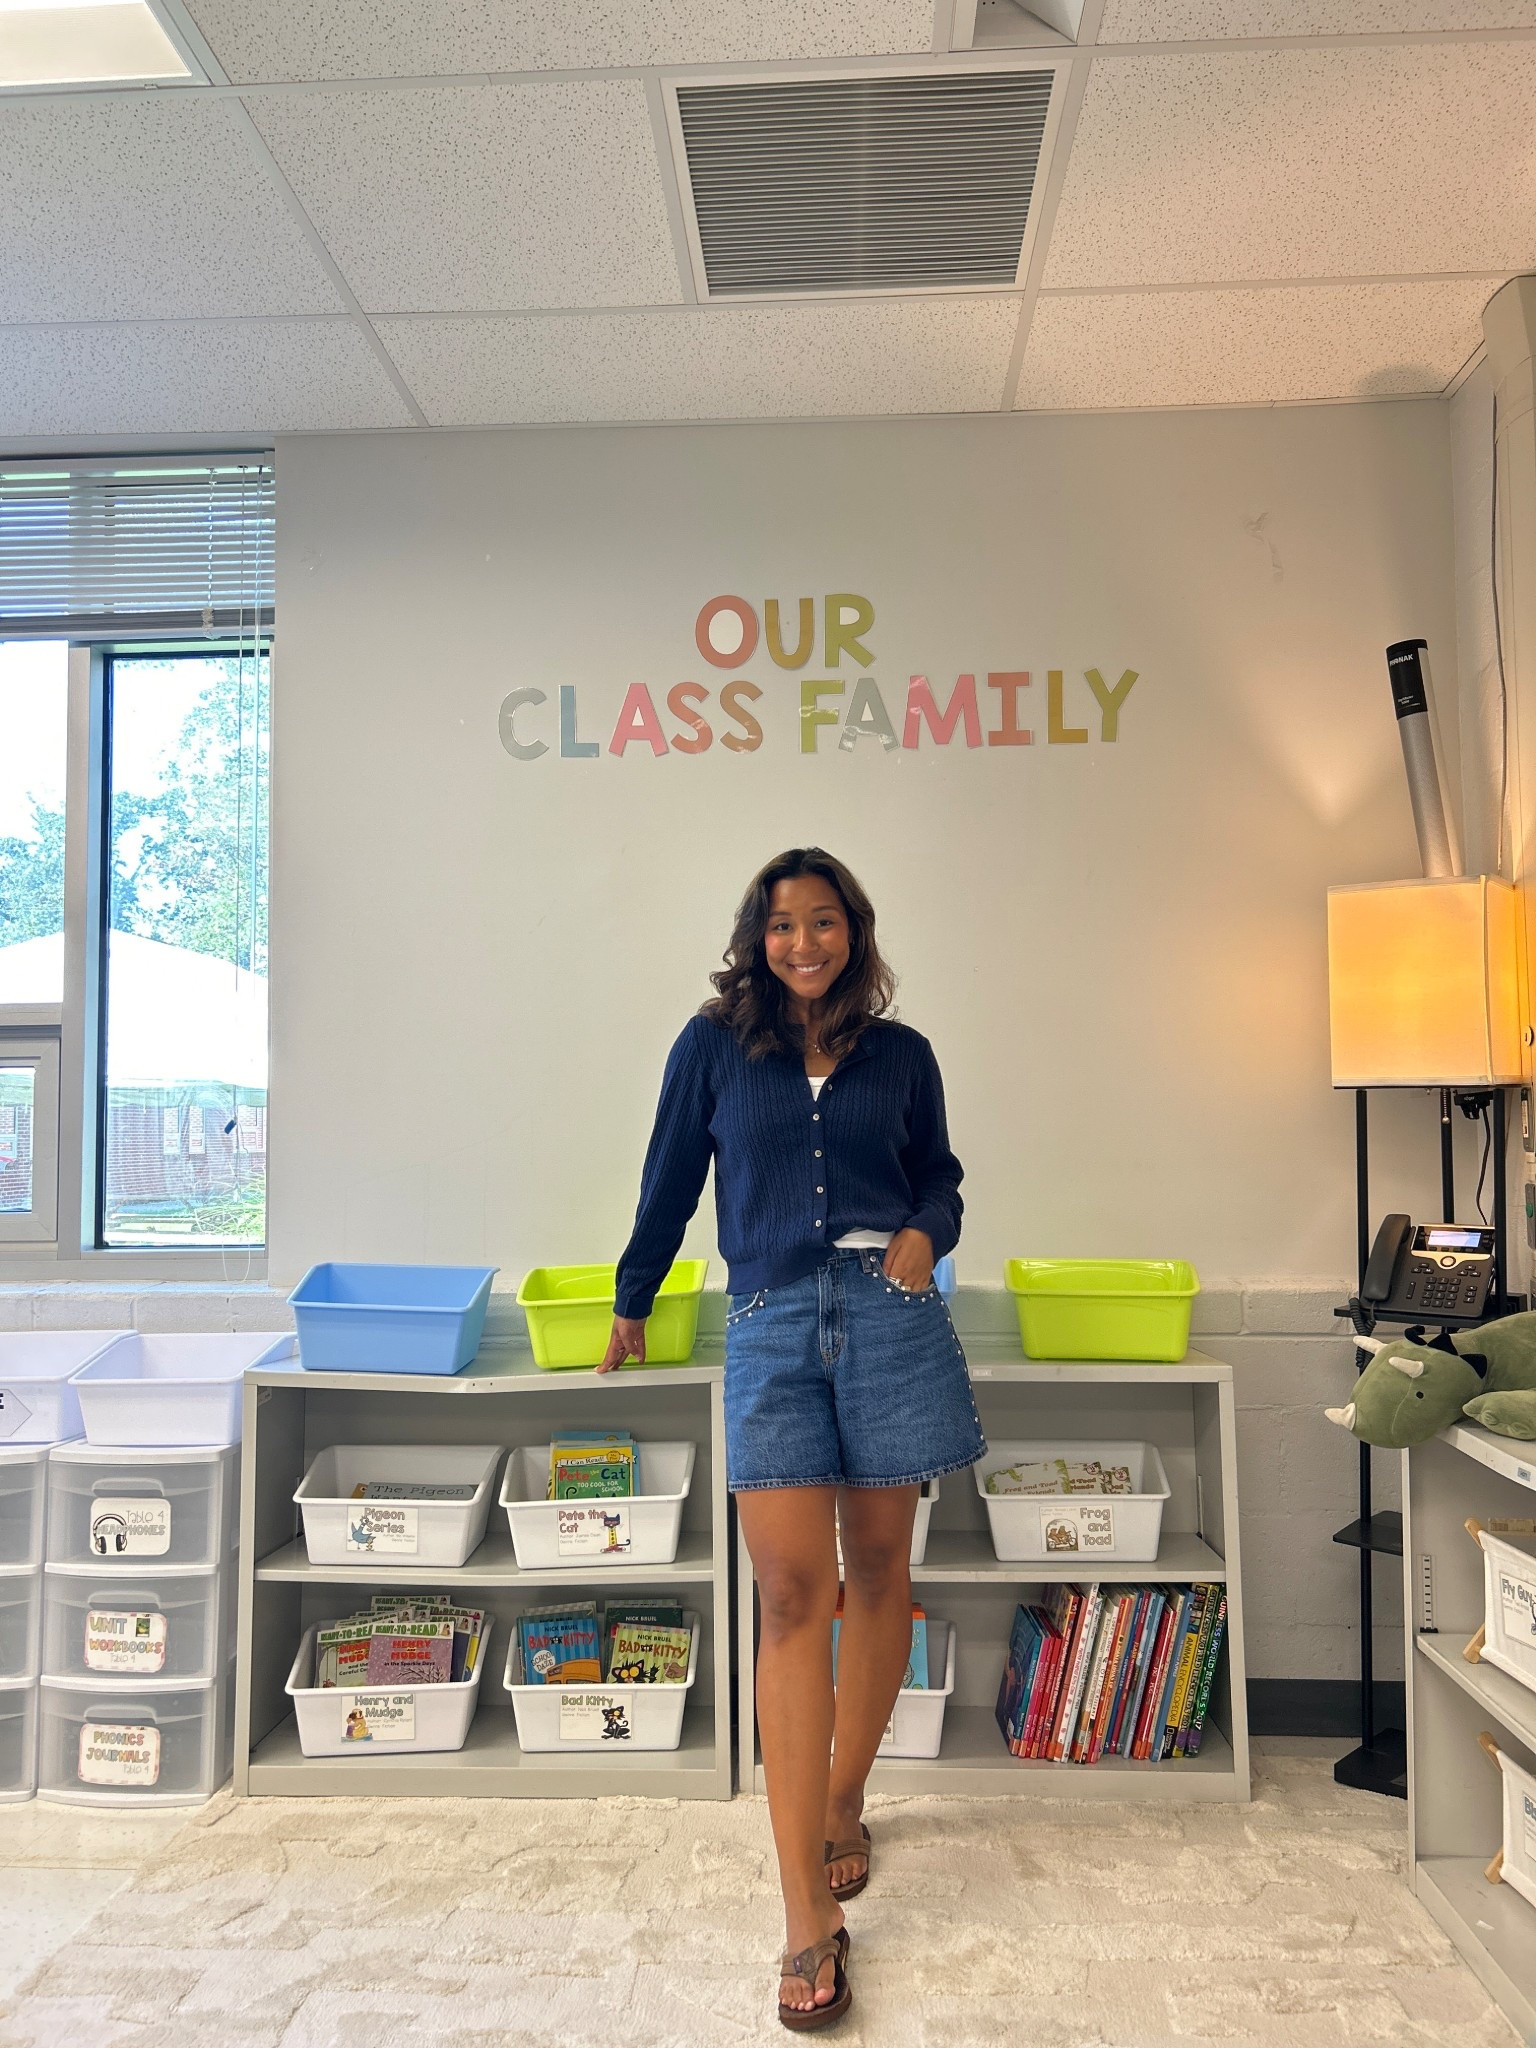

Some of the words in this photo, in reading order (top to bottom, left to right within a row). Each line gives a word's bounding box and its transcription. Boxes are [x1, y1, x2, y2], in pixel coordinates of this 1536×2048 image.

[695, 593, 876, 670] OUR
[498, 680, 763, 761] CLASS
[799, 667, 1140, 753] FAMILY
[560, 1467, 590, 1482] Pete
[601, 1467, 626, 1479] Cat
[374, 1485, 403, 1494] The
[409, 1486, 465, 1496] Pigeon
[589, 1480, 605, 1488] COOL
[1004, 1484, 1021, 1493] Frog
[1024, 1483, 1037, 1491] and
[1040, 1480, 1058, 1488] Toad
[126, 1510, 153, 1523] Table
[157, 1510, 164, 1522] 4
[364, 1507, 405, 1521] Pigeon
[559, 1510, 585, 1521] Pete
[588, 1509, 607, 1520] the
[1080, 1507, 1111, 1521] Frog
[97, 1524, 166, 1536] HEADPHONES
[366, 1521, 405, 1534] Series
[560, 1522, 579, 1534] Cat
[1088, 1521, 1112, 1532] and
[1083, 1533, 1112, 1546] Toad
[1502, 1578, 1516, 1600] Fly
[1518, 1584, 1534, 1608] Guy
[1203, 1589, 1217, 1634] GUINNESS
[1214, 1595, 1228, 1637] GUINNESS
[90, 1616, 128, 1635] UNIT
[410, 1624, 438, 1637] READ
[544, 1622, 559, 1633] NICK
[560, 1620, 579, 1631] BRUEL
[391, 1640, 432, 1649] HENRY
[528, 1635, 550, 1649] BAD
[563, 1632, 595, 1647] KITTY
[637, 1634, 653, 1642] NICK
[654, 1635, 672, 1643] BRUEL
[89, 1638, 164, 1654] WORKBOOKS
[618, 1640, 641, 1653] BAD
[652, 1644, 688, 1660] KITTY
[1181, 1636, 1194, 1668] ANIMAL
[1195, 1634, 1208, 1669] WORLD
[390, 1651, 432, 1660] MUDGE
[1206, 1638, 1220, 1670] WORLD
[536, 1658, 553, 1671] DAZE
[1169, 1669, 1187, 1722] ENCYCLOPEDIA
[1186, 1669, 1200, 1715] RECORDS
[1199, 1670, 1213, 1711] RECORDS
[354, 1695, 390, 1707] Henry
[393, 1694, 414, 1705] and
[561, 1694, 584, 1706] Bad
[586, 1695, 614, 1708] Kitty
[364, 1706, 404, 1719] Mudge
[1194, 1711, 1205, 1731] 2017
[93, 1730, 145, 1746] PHONICS
[85, 1747, 151, 1764] JOURNALS
